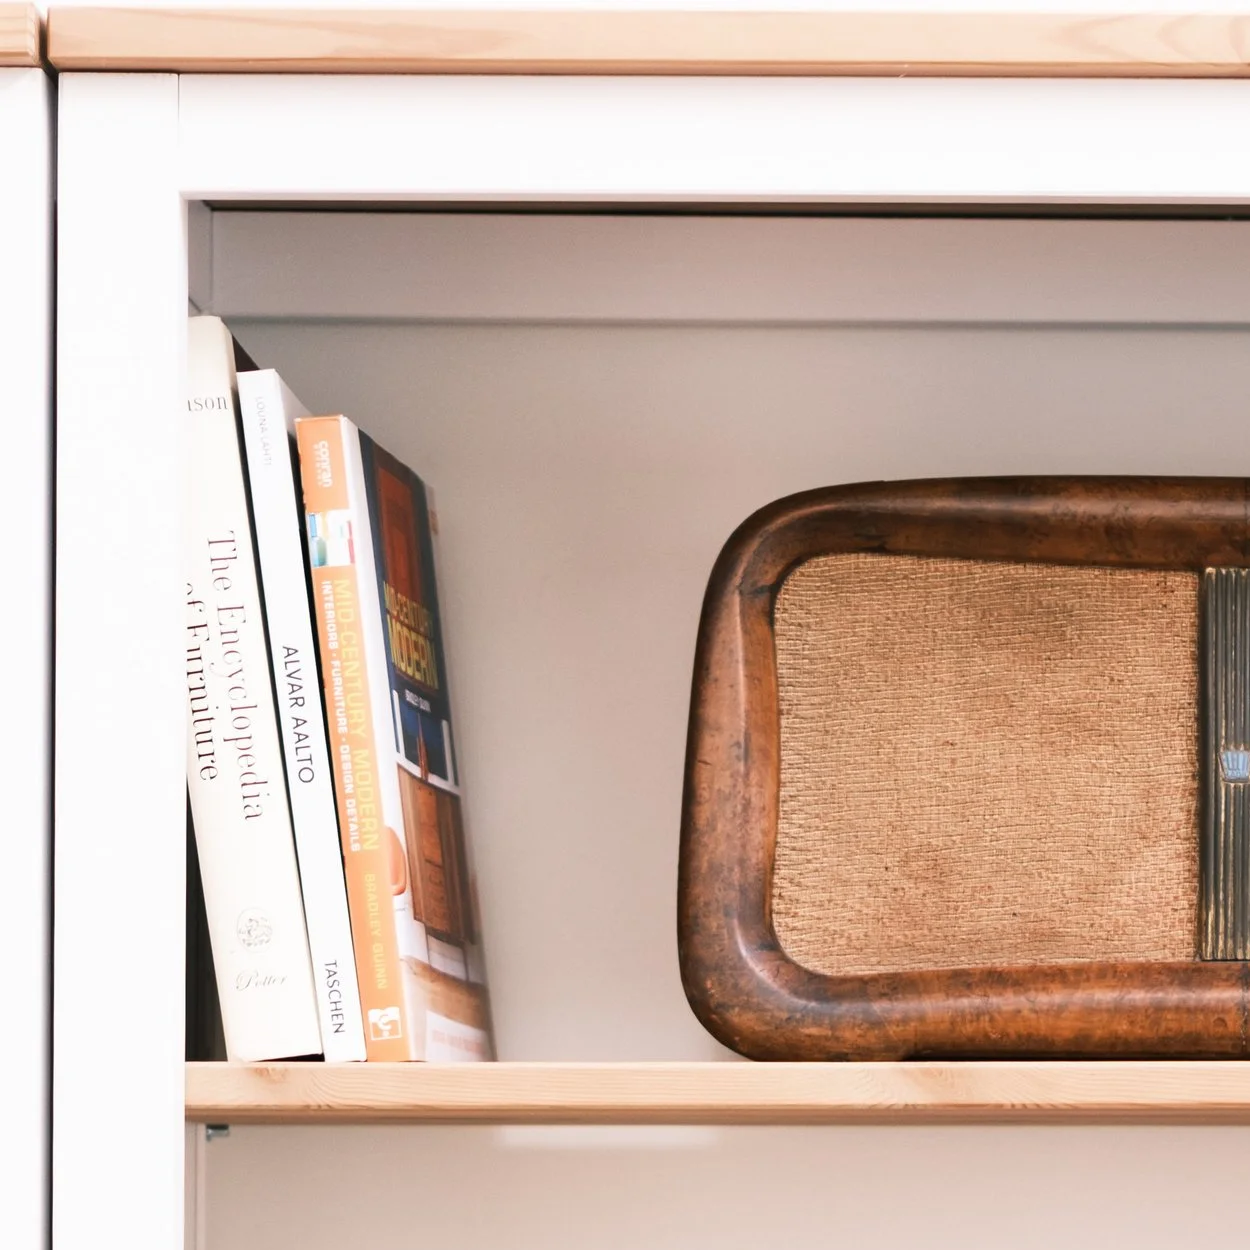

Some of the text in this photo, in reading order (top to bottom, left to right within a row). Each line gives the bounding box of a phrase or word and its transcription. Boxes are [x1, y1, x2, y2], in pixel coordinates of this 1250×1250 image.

[255, 396, 268, 433] LOUNA
[319, 440, 333, 487] conran
[208, 531, 270, 820] The Encyclopedia
[282, 645, 315, 784] ALVAR AALTO
[321, 582, 361, 852] INTERIORS FURNITURE DESIGN DETAILS
[334, 579, 380, 850] MID-CENTURY MODERN
[236, 968, 288, 992] Potter
[364, 873, 387, 989] BRADLEY QUINN
[324, 959, 346, 1034] TASCHEN
